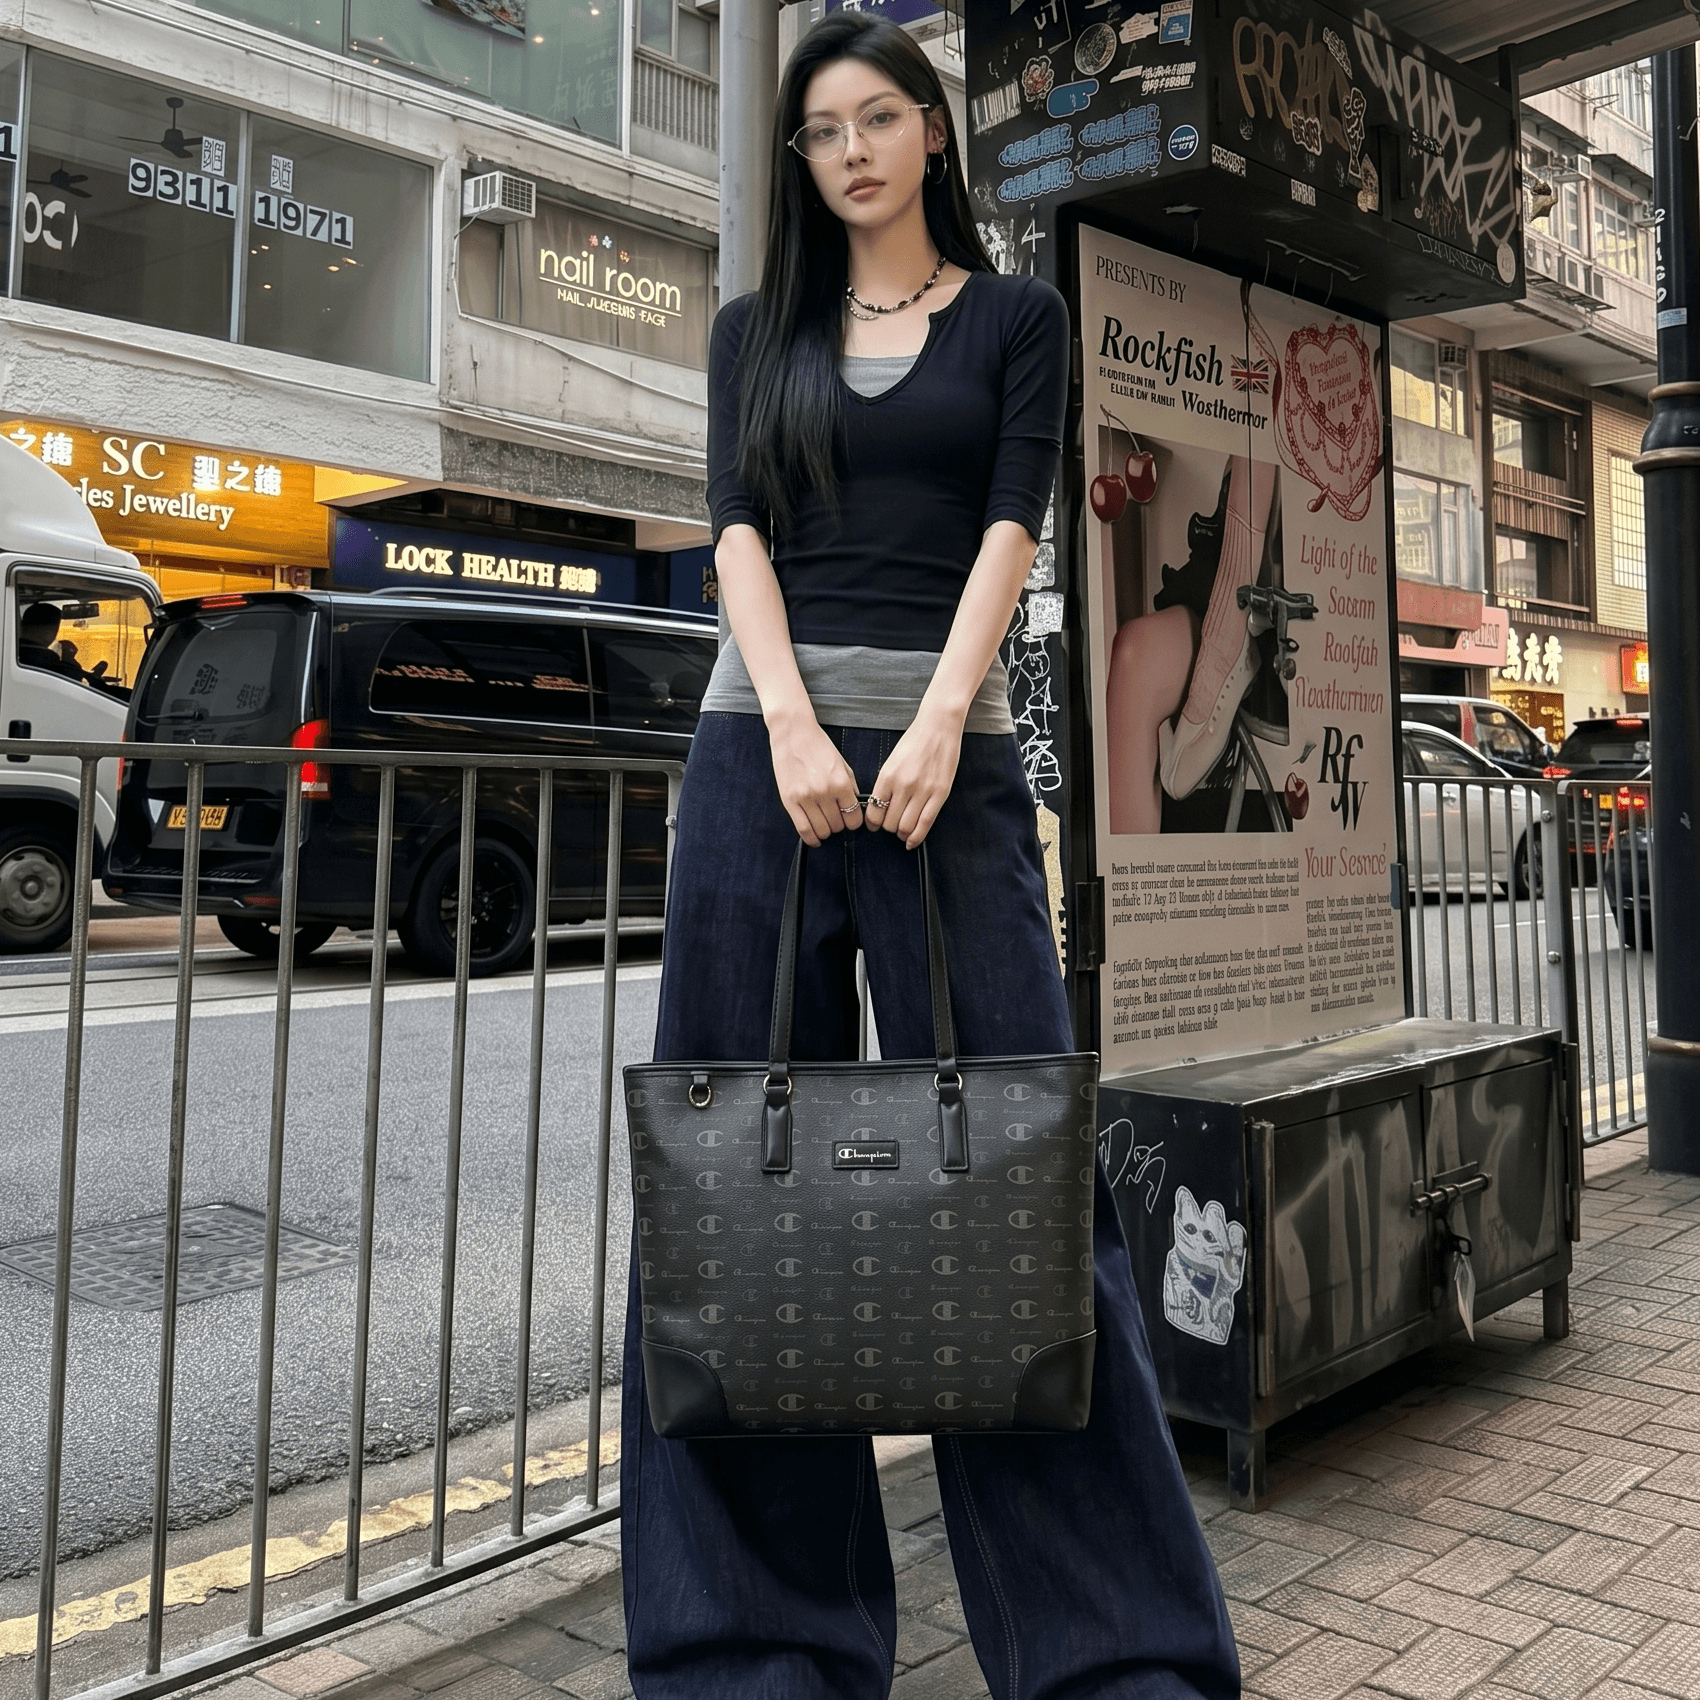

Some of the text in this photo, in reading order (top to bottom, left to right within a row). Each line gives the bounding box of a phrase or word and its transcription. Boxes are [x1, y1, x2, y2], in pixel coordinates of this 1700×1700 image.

[130, 161, 235, 217] 9311
[256, 194, 352, 246] 1971
[540, 249, 681, 311] nail room
[1095, 254, 1187, 304] PRESENTS BY
[1099, 315, 1224, 386] Rockfish
[102, 436, 166, 480] SC
[118, 484, 235, 531] Jewellery
[385, 543, 454, 576] LOCK
[461, 552, 556, 587] HEALTH
[1340, 543, 1356, 581] of
[1358, 544, 1378, 576] the
[1305, 846, 1337, 878] Your
